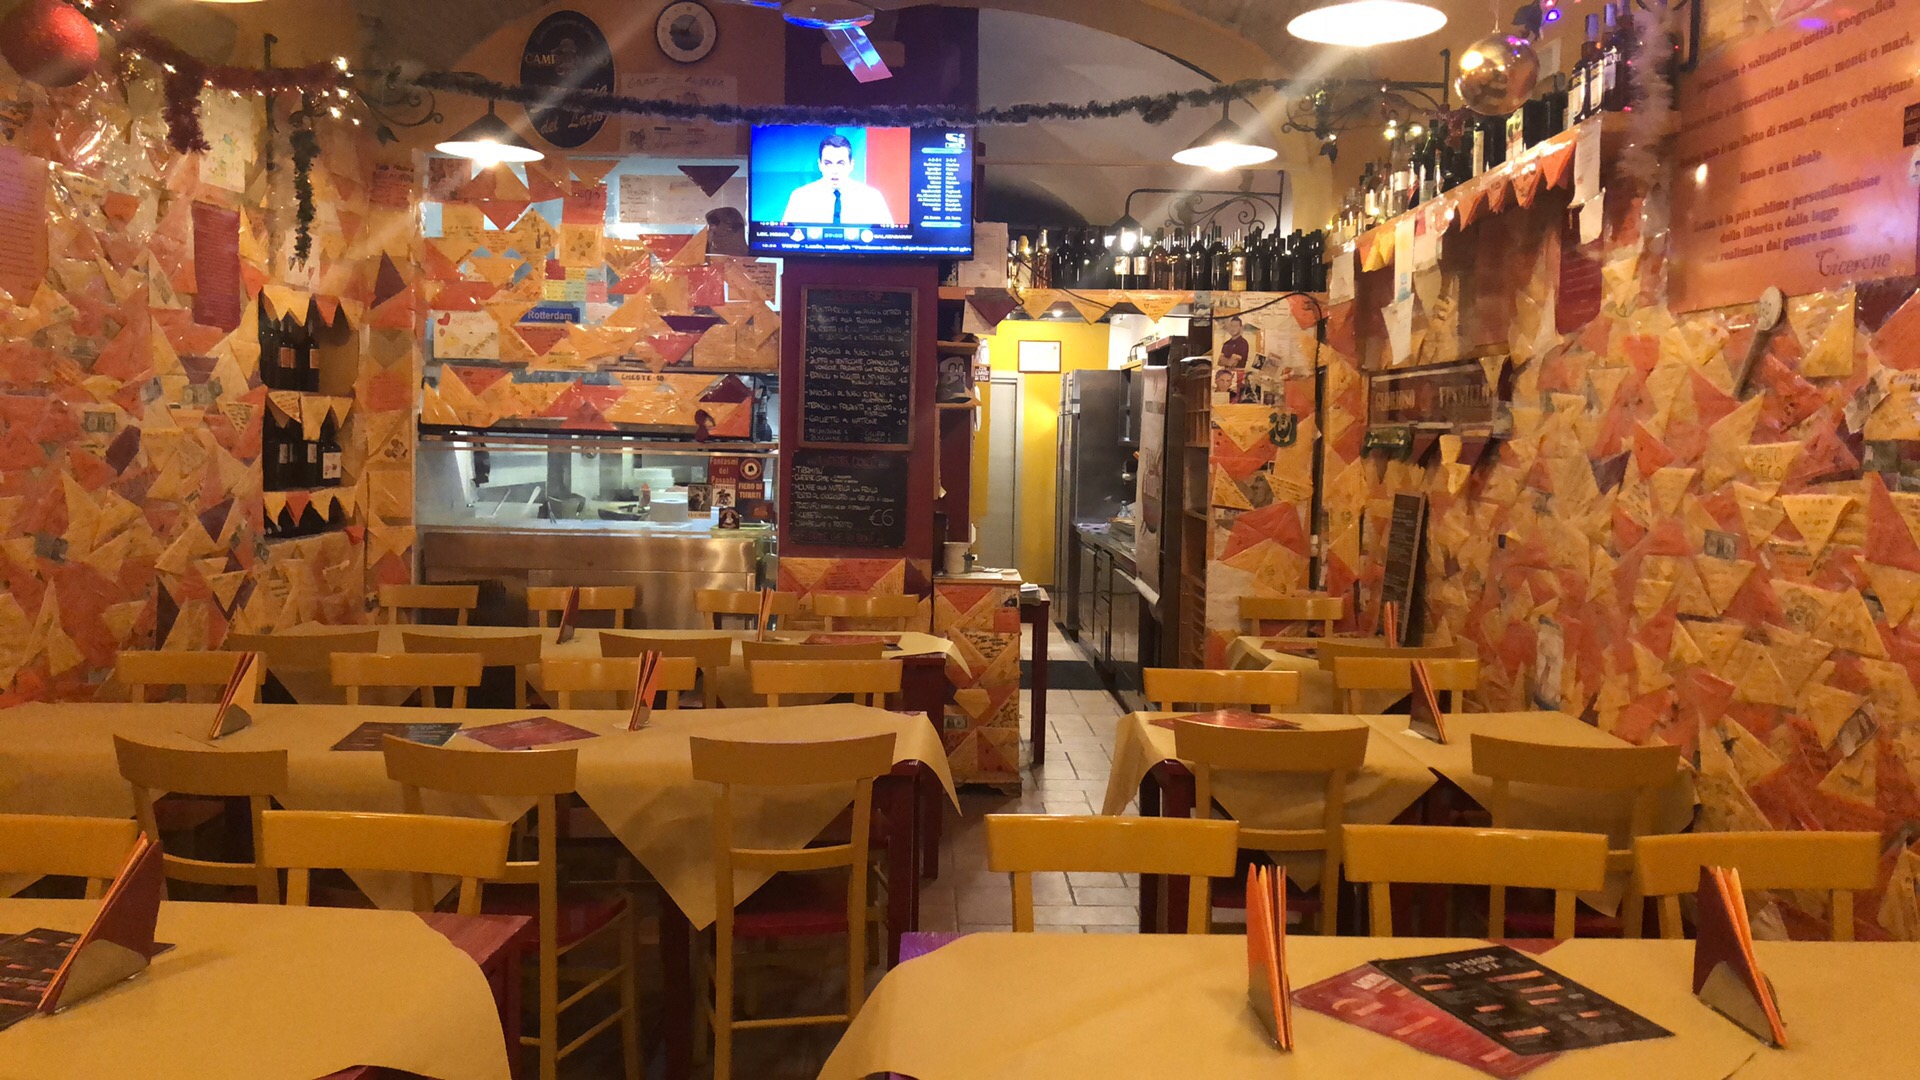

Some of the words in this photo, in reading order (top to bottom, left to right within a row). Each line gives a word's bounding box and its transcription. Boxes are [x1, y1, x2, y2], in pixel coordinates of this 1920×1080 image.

[1748, 46, 1787, 71] soltanto
[1787, 79, 1799, 92] da
[1834, 48, 1867, 73] monti
[1870, 48, 1878, 59] o
[1766, 125, 1777, 139] di
[1810, 101, 1848, 123] sangue
[1850, 97, 1858, 108] o
[1739, 167, 1767, 184] Roma
[1777, 161, 1789, 173] un
[1791, 149, 1822, 168] ideale
[1753, 199, 1790, 218] sublime
[1784, 212, 1809, 228] della
[1811, 207, 1840, 223] legge
[1783, 232, 1817, 252] genere
[527, 310, 574, 321] Rotterdam
